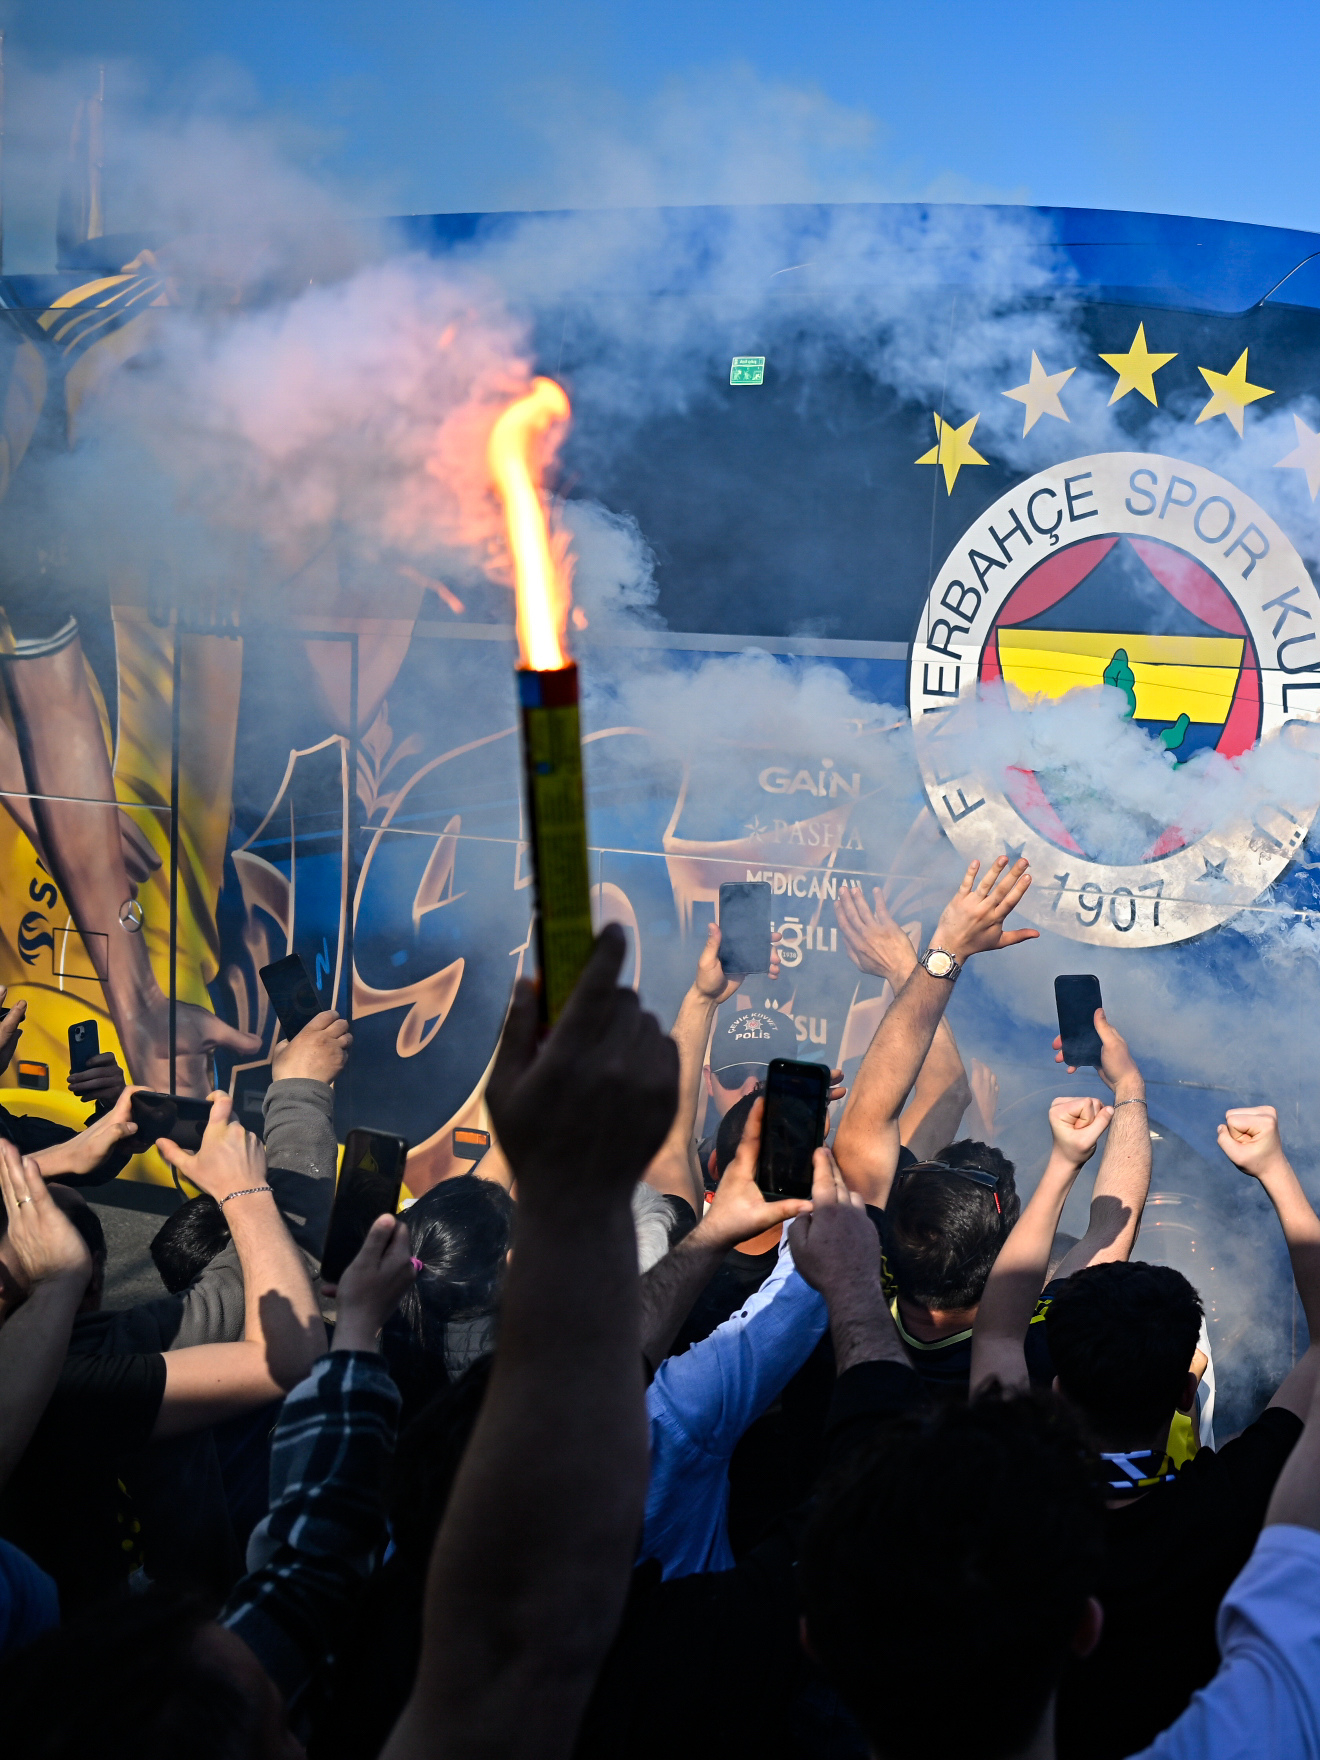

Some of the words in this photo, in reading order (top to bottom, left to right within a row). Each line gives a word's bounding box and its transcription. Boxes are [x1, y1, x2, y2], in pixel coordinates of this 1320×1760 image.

[1125, 469, 1271, 580] SPOR
[773, 819, 865, 850] PASHA
[1052, 872, 1165, 932] 1907
